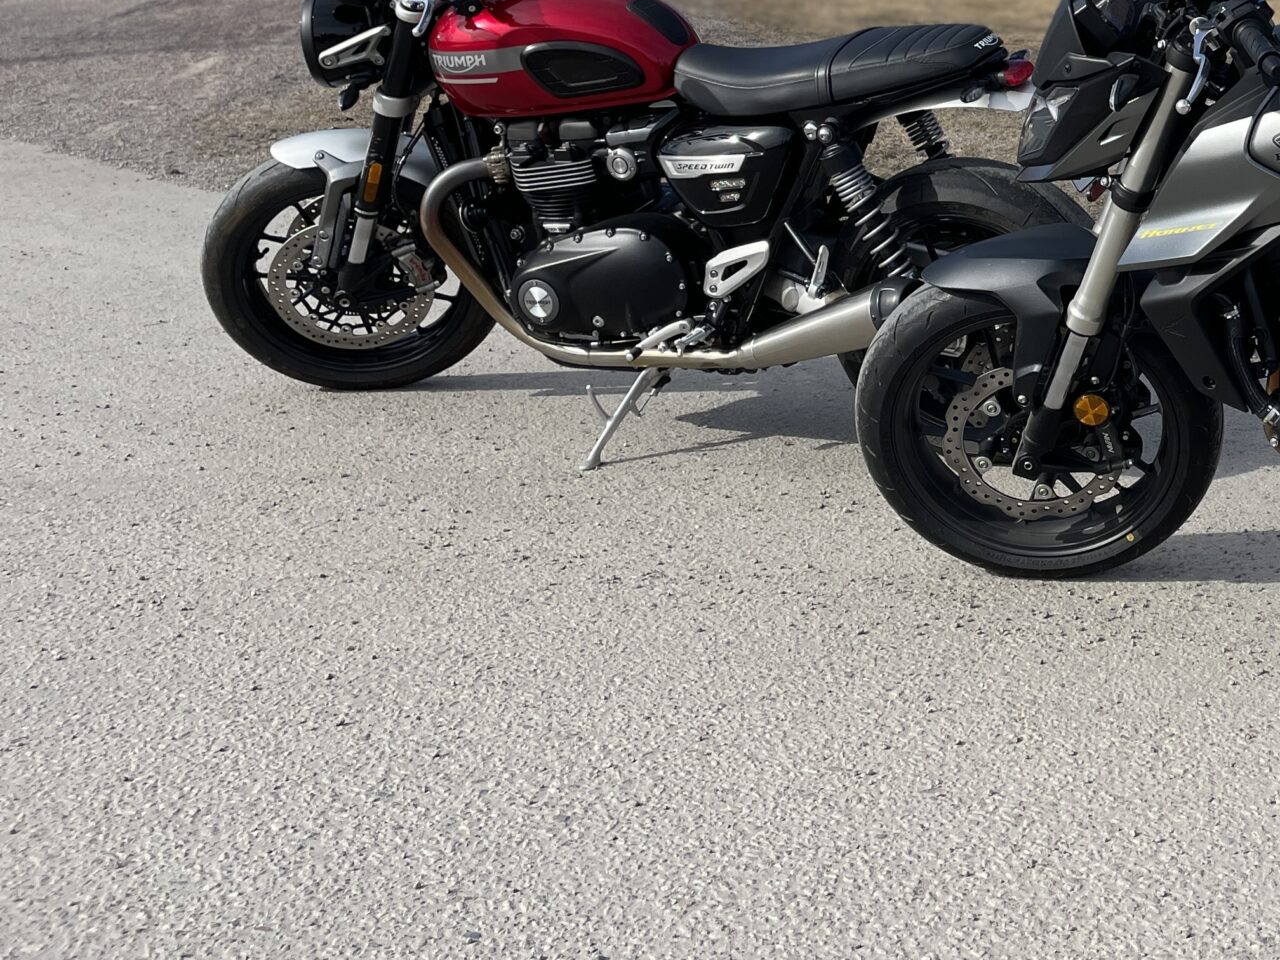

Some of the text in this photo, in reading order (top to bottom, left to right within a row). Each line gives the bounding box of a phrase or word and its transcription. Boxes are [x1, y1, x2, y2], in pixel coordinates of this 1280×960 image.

[432, 54, 487, 73] TRIUMPH
[676, 162, 735, 171] SPEED TWIN
